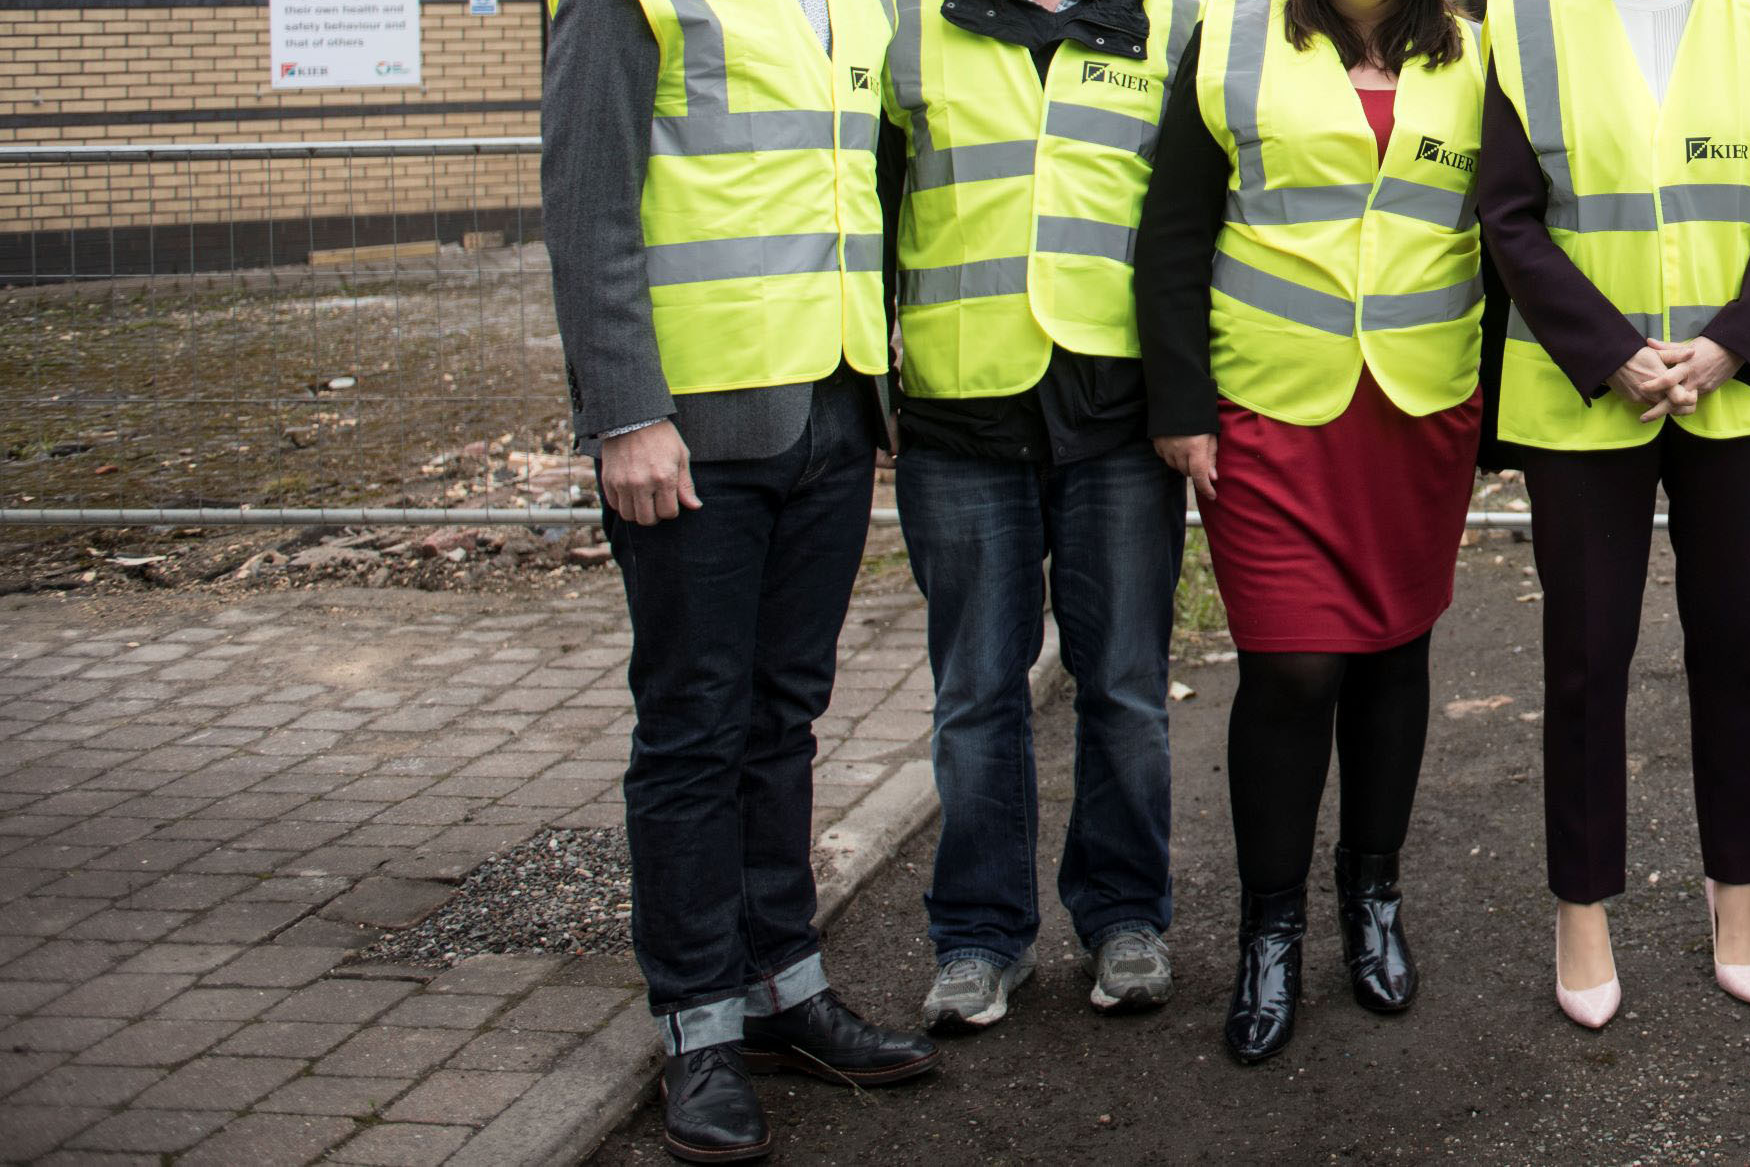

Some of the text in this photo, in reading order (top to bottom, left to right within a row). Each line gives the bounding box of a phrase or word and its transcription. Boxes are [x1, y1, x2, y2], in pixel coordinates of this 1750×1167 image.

[343, 4, 378, 13] health
[383, 4, 404, 13] and
[324, 21, 381, 30] behaviour
[385, 20, 406, 30] and
[327, 37, 364, 47] others
[1108, 70, 1149, 94] KIER
[1710, 144, 1748, 159] KIER
[1439, 149, 1474, 173] KIER
